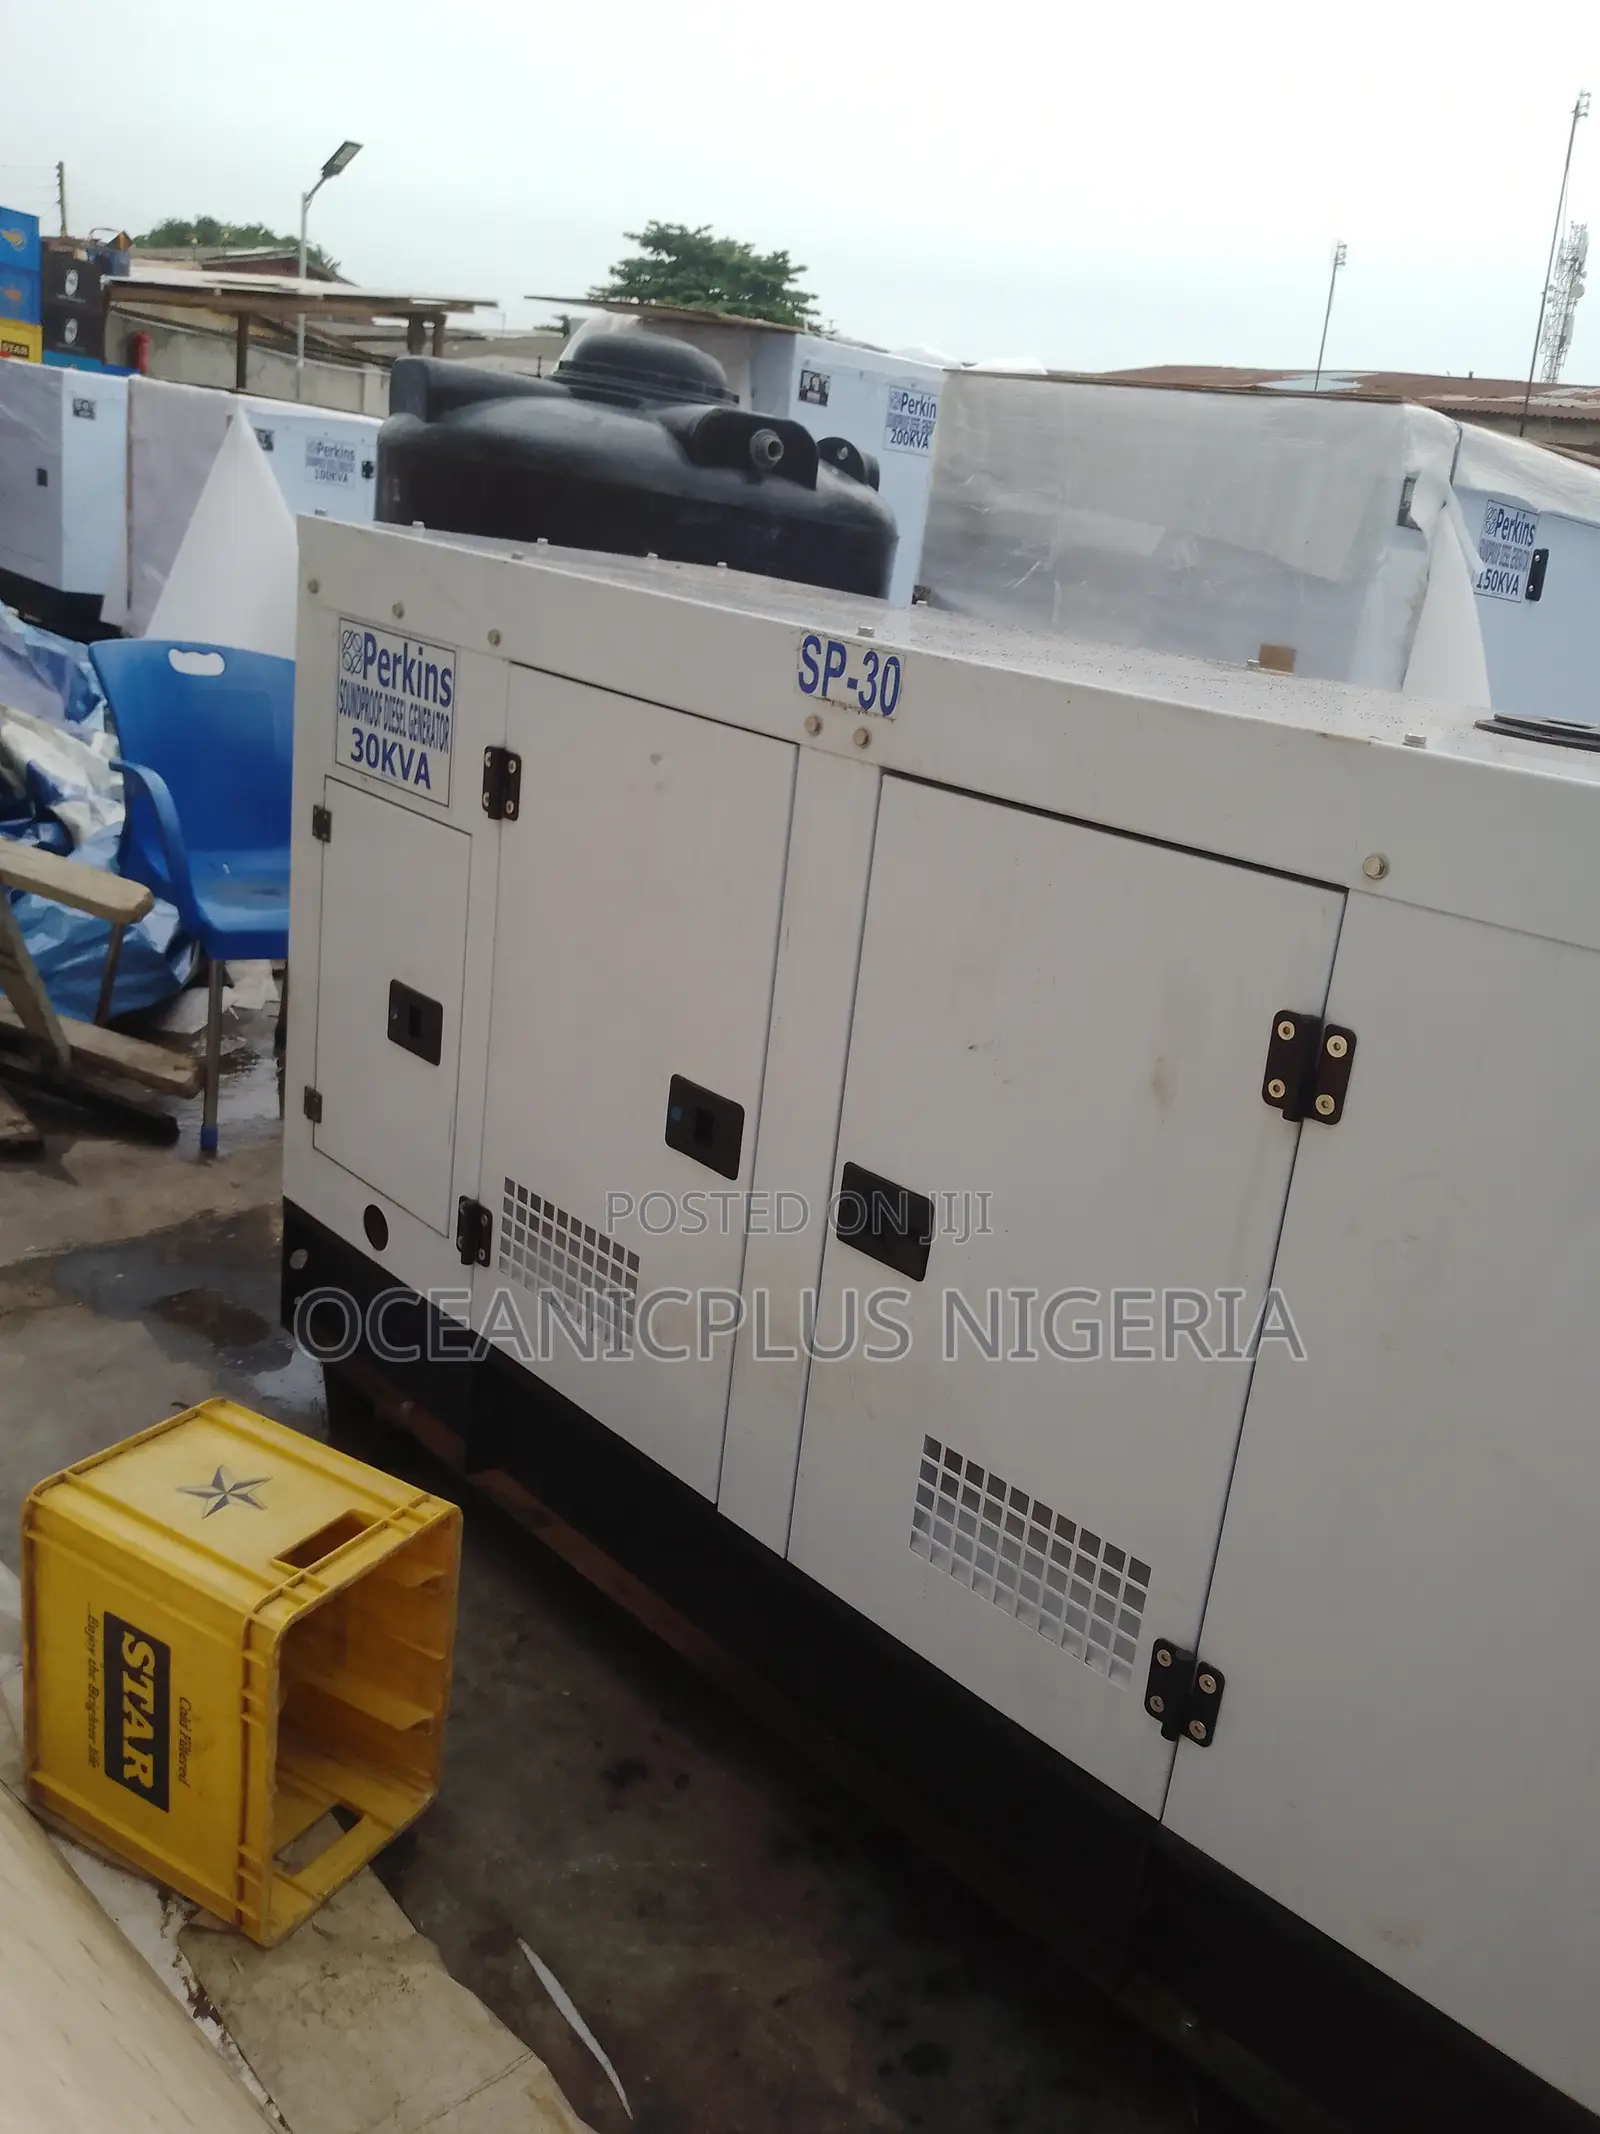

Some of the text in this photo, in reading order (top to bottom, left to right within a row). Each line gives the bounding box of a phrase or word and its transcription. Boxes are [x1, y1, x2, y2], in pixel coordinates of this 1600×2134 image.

[900, 391, 937, 420] Perkin
[317, 441, 356, 462] Perkins
[890, 428, 930, 450] 200KVA
[1493, 508, 1537, 548] Perkins
[1475, 567, 1521, 596] 150KVA
[362, 631, 453, 708] Perkins
[798, 634, 901, 717] SP-30
[339, 678, 450, 755] SOUNDPROOF DIESEL GENERATOR
[350, 727, 432, 790] 30KVA
[121, 1631, 156, 1789] STAR
[177, 1696, 192, 1788] Cold Filtered
